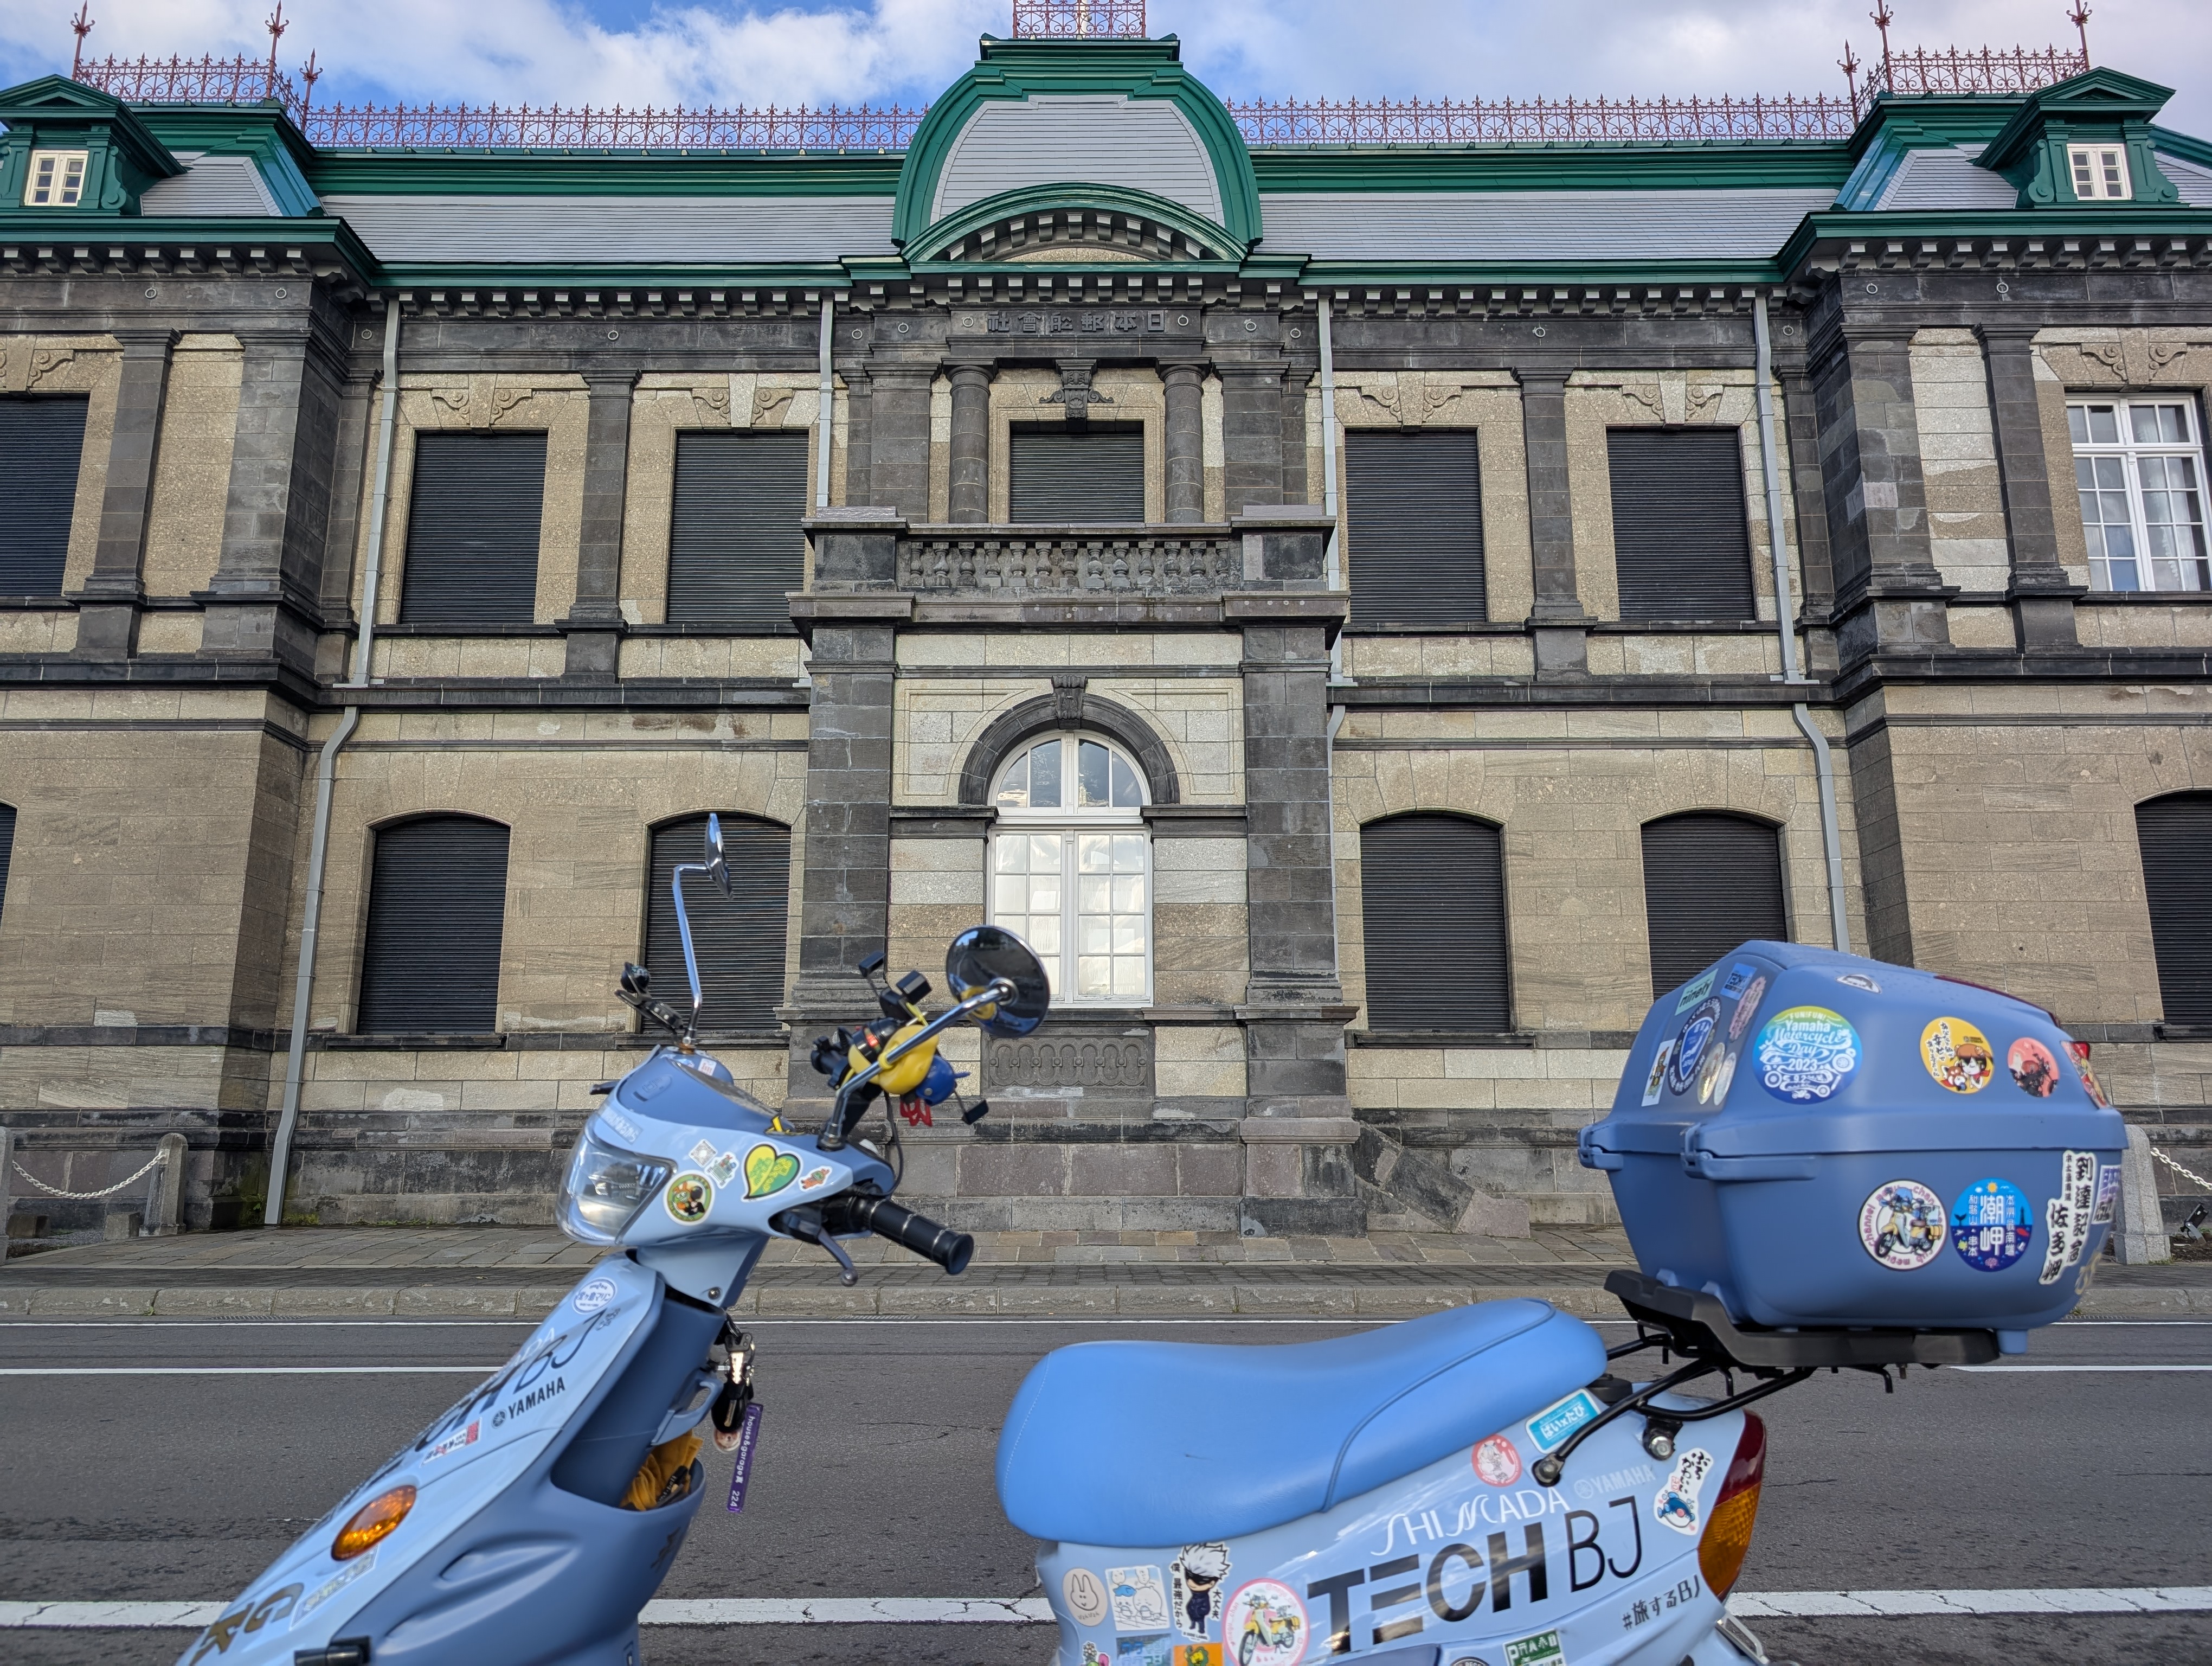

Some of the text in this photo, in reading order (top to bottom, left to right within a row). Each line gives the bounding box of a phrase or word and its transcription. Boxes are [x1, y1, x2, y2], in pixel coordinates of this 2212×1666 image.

[1765, 1026, 1842, 1045] Motorcycle
[1785, 1020, 1831, 1032] Yamaha
[1787, 1042, 1817, 1058] Day
[1789, 1058, 1818, 1071] 2023
[1980, 1194, 2005, 1257] 潮岬
[2042, 1202, 2069, 1281] 佐多岬
[508, 1376, 565, 1419] YAMAHA
[1590, 1464, 1656, 1494] YAMAHA
[730, 1490, 740, 1507] 224
[1307, 1495, 1643, 1654] TECH BJ
[1173, 1578, 1184, 1628] 最強だから
[1212, 1589, 1221, 1619] 大丈夫
